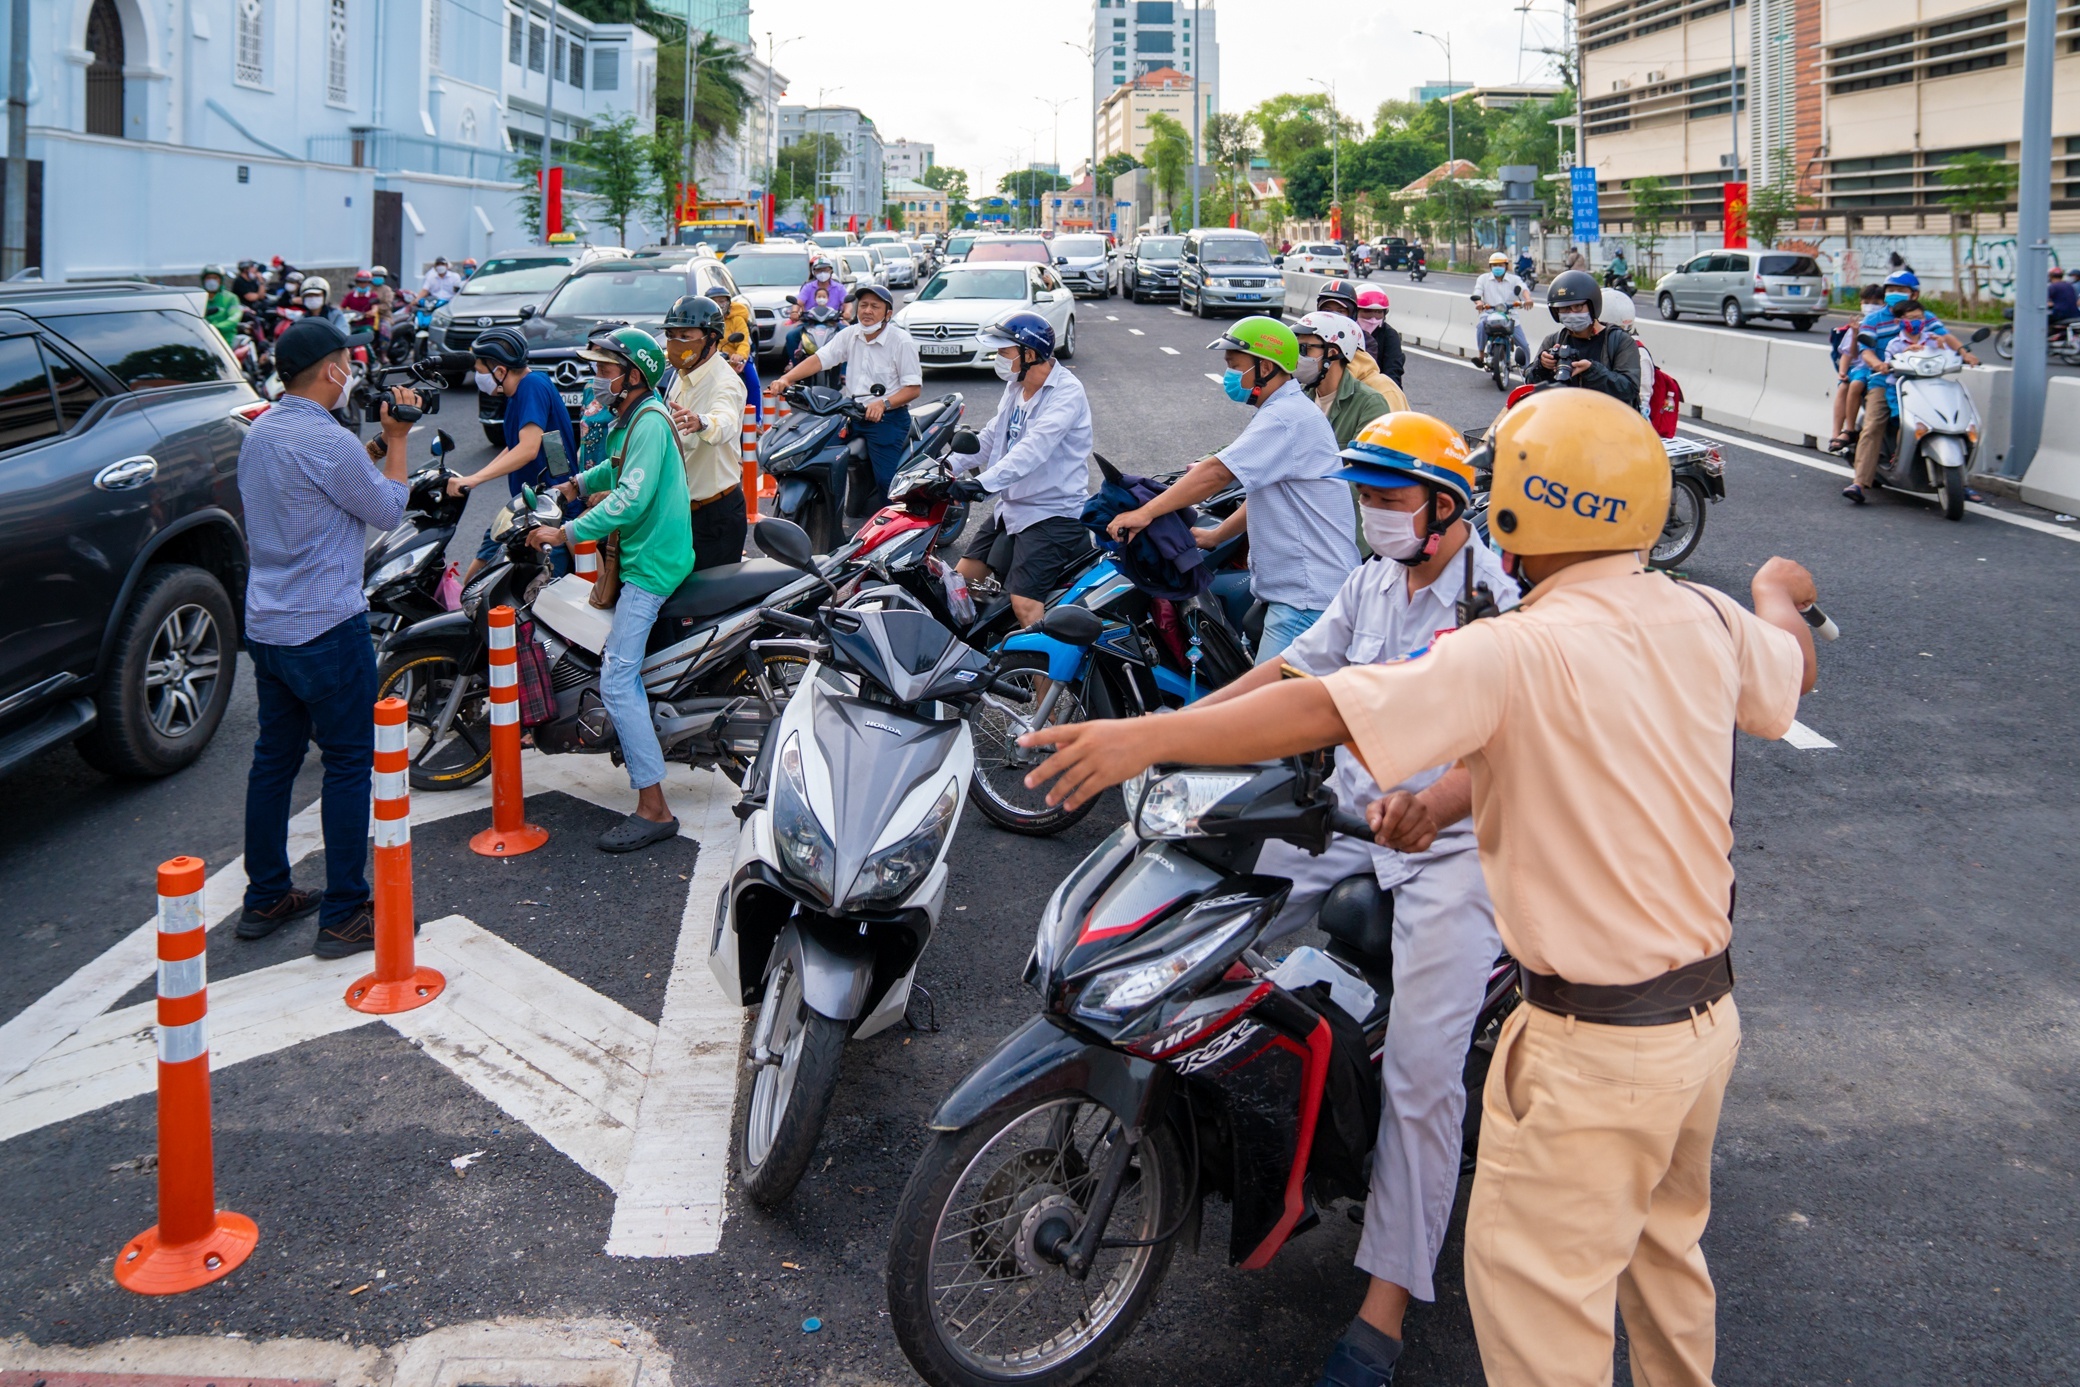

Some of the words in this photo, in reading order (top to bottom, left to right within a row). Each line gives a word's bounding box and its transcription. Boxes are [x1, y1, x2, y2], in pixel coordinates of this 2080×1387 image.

[637, 348, 658, 373] Grab
[604, 467, 645, 516] Grab
[1523, 475, 1626, 523] CSGT
[865, 720, 902, 736] HONDA
[1143, 852, 1175, 873] HONDA
